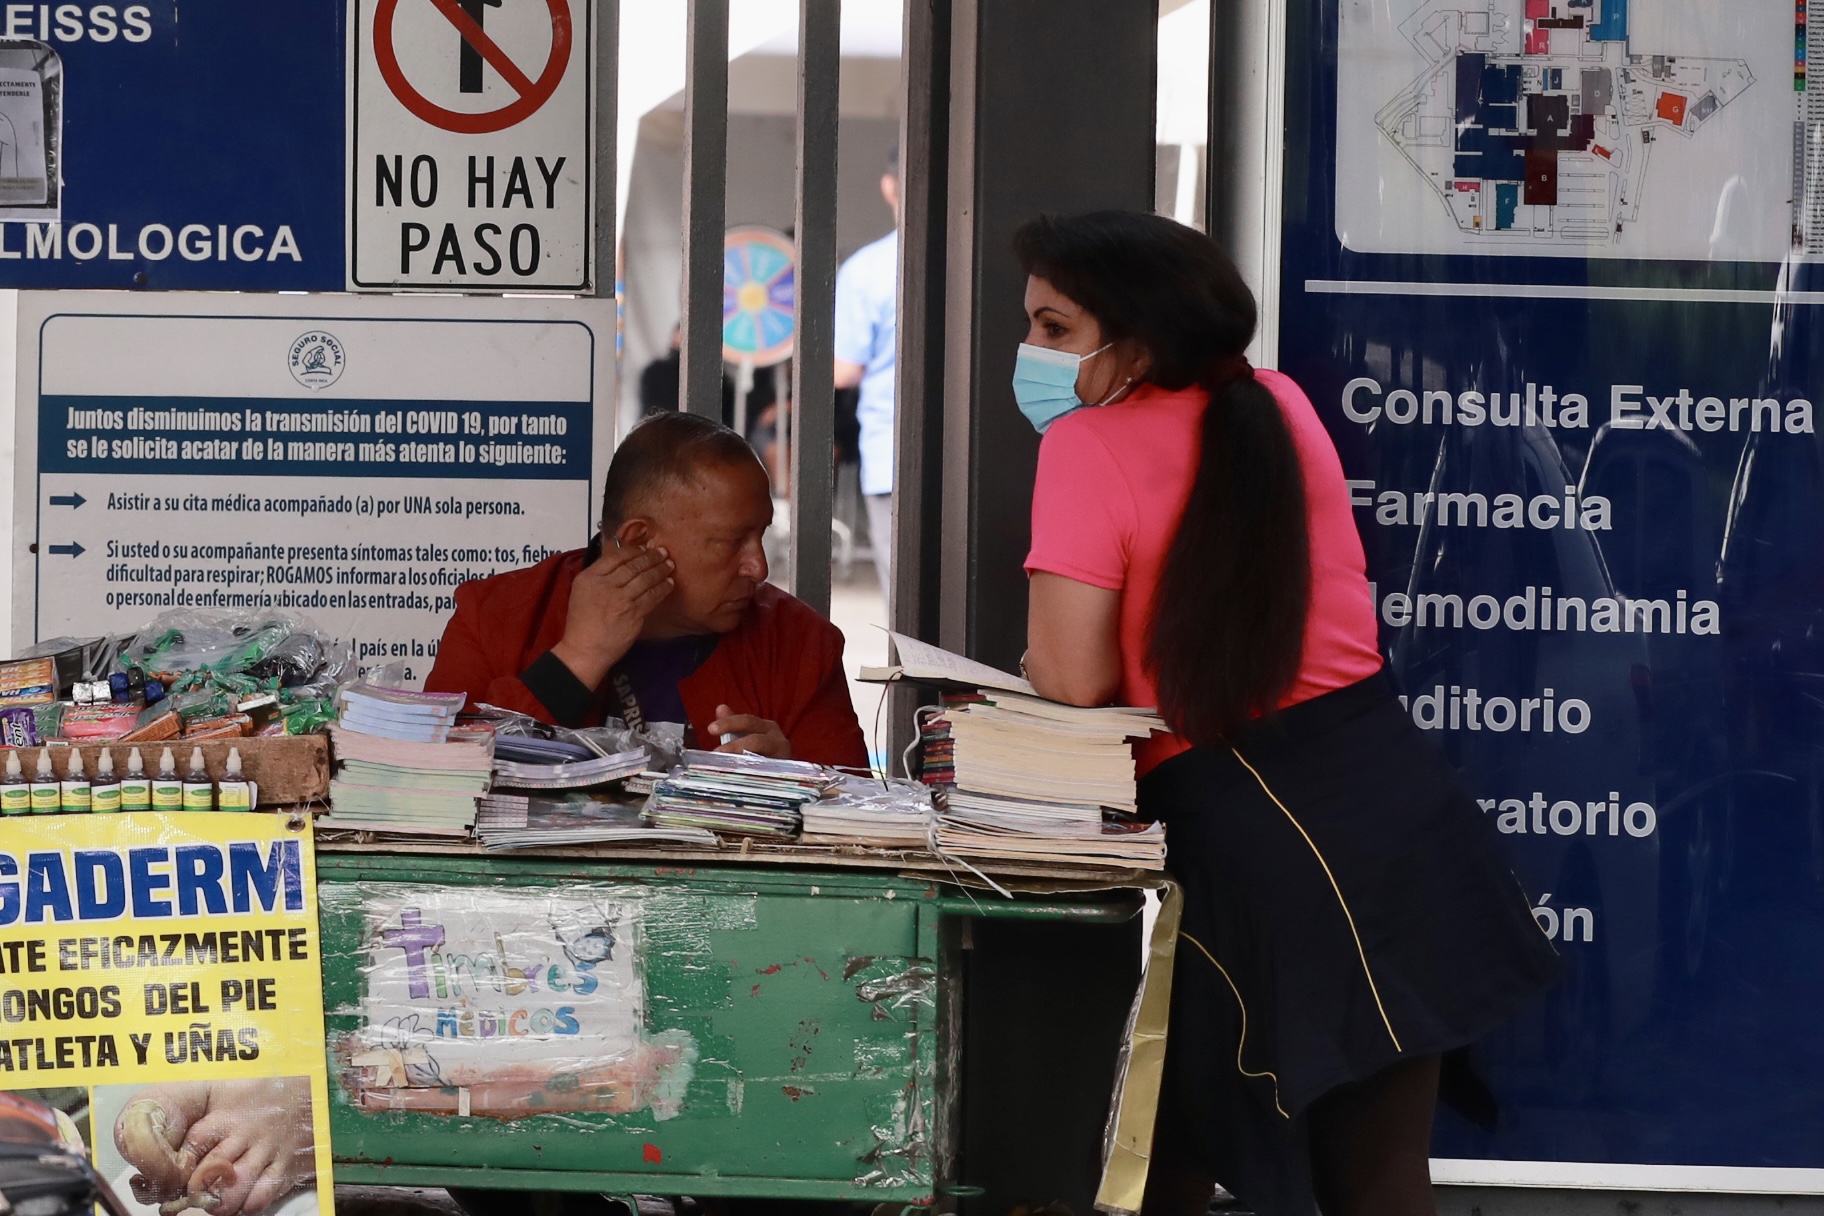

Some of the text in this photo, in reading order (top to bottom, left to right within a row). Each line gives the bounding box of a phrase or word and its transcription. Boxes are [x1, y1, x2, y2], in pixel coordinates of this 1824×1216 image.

[1547, 114, 1554, 122] A
[376, 154, 567, 210] NO HAY
[401, 223, 541, 276] PASO
[292, 335, 342, 366] SEGURO SOCIAL
[66, 406, 567, 436] Juntos disminuimos la transmisión del COVID 19, por tanto
[1341, 377, 1815, 434] Consulta Externa
[66, 436, 567, 466] se le solicita acatar de la manera más atenta lo siguiente:
[107, 492, 525, 519] Asistir a su cita médica acompañado (a) por UNA sola persona.
[1345, 479, 1613, 530] Farmacia
[106, 540, 119, 558] Si
[121, 540, 159, 559] usted
[162, 544, 170, 559] o
[173, 545, 188, 559] su
[190, 542, 285, 563] acompañante
[288, 544, 348, 564] presenta
[351, 543, 413, 562] síntomas
[415, 544, 449, 562] tales
[451, 548, 492, 562] como:
[495, 547, 520, 565] tos,
[106, 564, 172, 582] dificultad
[174, 568, 204, 586] para
[207, 566, 264, 587] respirar;
[267, 566, 333, 584] ROGAMOS
[337, 568, 397, 585] informar
[398, 570, 406, 585] a
[408, 567, 427, 585] los
[106, 592, 114, 606] o
[116, 588, 174, 610] personal
[177, 589, 193, 606] de
[196, 589, 272, 607] enfermería
[273, 590, 327, 608] ubicado
[330, 595, 346, 608] en
[348, 590, 366, 608] las
[368, 591, 434, 612] entradas,
[1367, 581, 1721, 635] emodinamia
[360, 638, 387, 660] país
[391, 643, 408, 656] en
[411, 638, 424, 656] la
[1398, 685, 1592, 734] ditorio
[1476, 792, 1658, 838] ratorio
[59, 928, 308, 971] EFICAZMENTE
[382, 907, 598, 999] Timbres
[144, 979, 208, 1017] DEL
[221, 978, 277, 1012] PIE
[130, 1030, 153, 1066] Y
[164, 1021, 260, 1064] UÑAS
